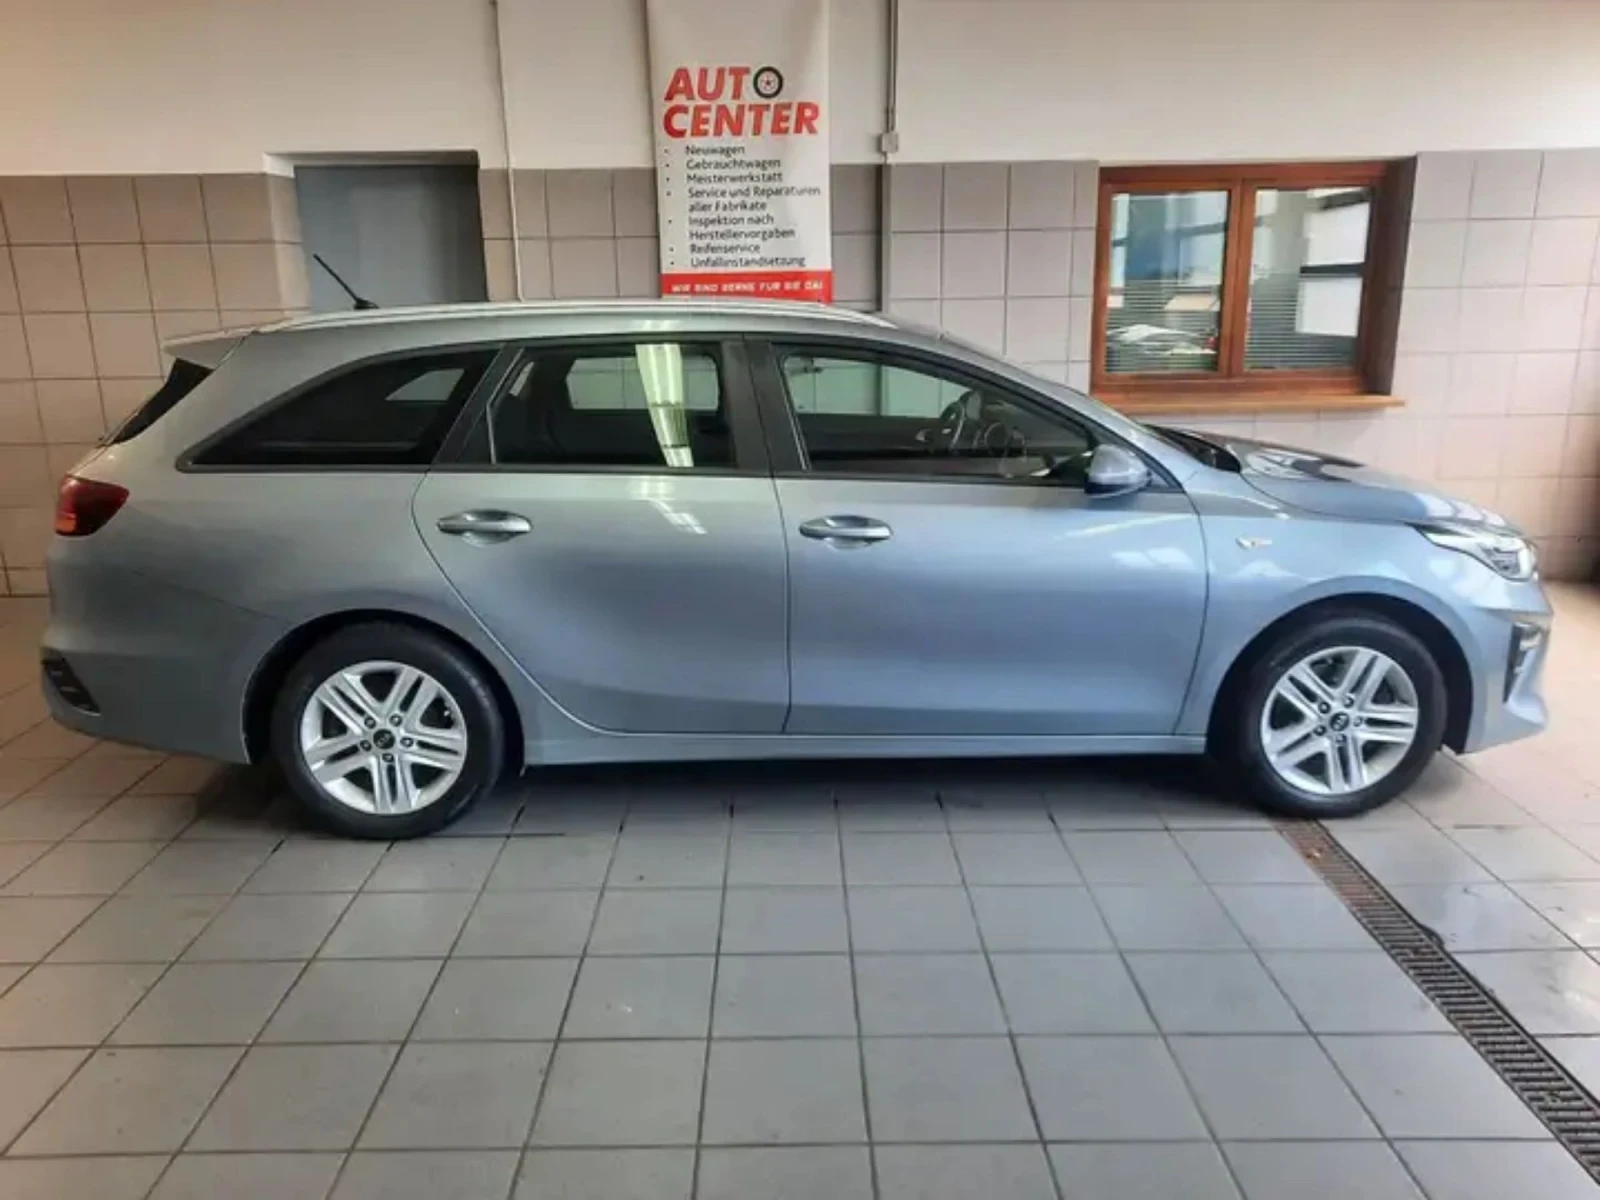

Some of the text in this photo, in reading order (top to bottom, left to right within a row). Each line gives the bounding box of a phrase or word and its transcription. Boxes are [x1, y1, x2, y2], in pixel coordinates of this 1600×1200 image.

[663, 102, 819, 138] CENTER
[686, 145, 745, 158] Neuwagen
[686, 158, 781, 171] Gebrauchtwagen
[686, 172, 783, 183] Meisterwerkstatt
[688, 186, 821, 199] Service und Reparaturen
[689, 200, 767, 212] aller Fabrikate
[689, 213, 774, 228] Inspektion nach
[689, 228, 795, 242] Herstellervorgaben
[690, 241, 761, 254] Reifenservice
[691, 257, 806, 268] Unfallinstandsetzung
